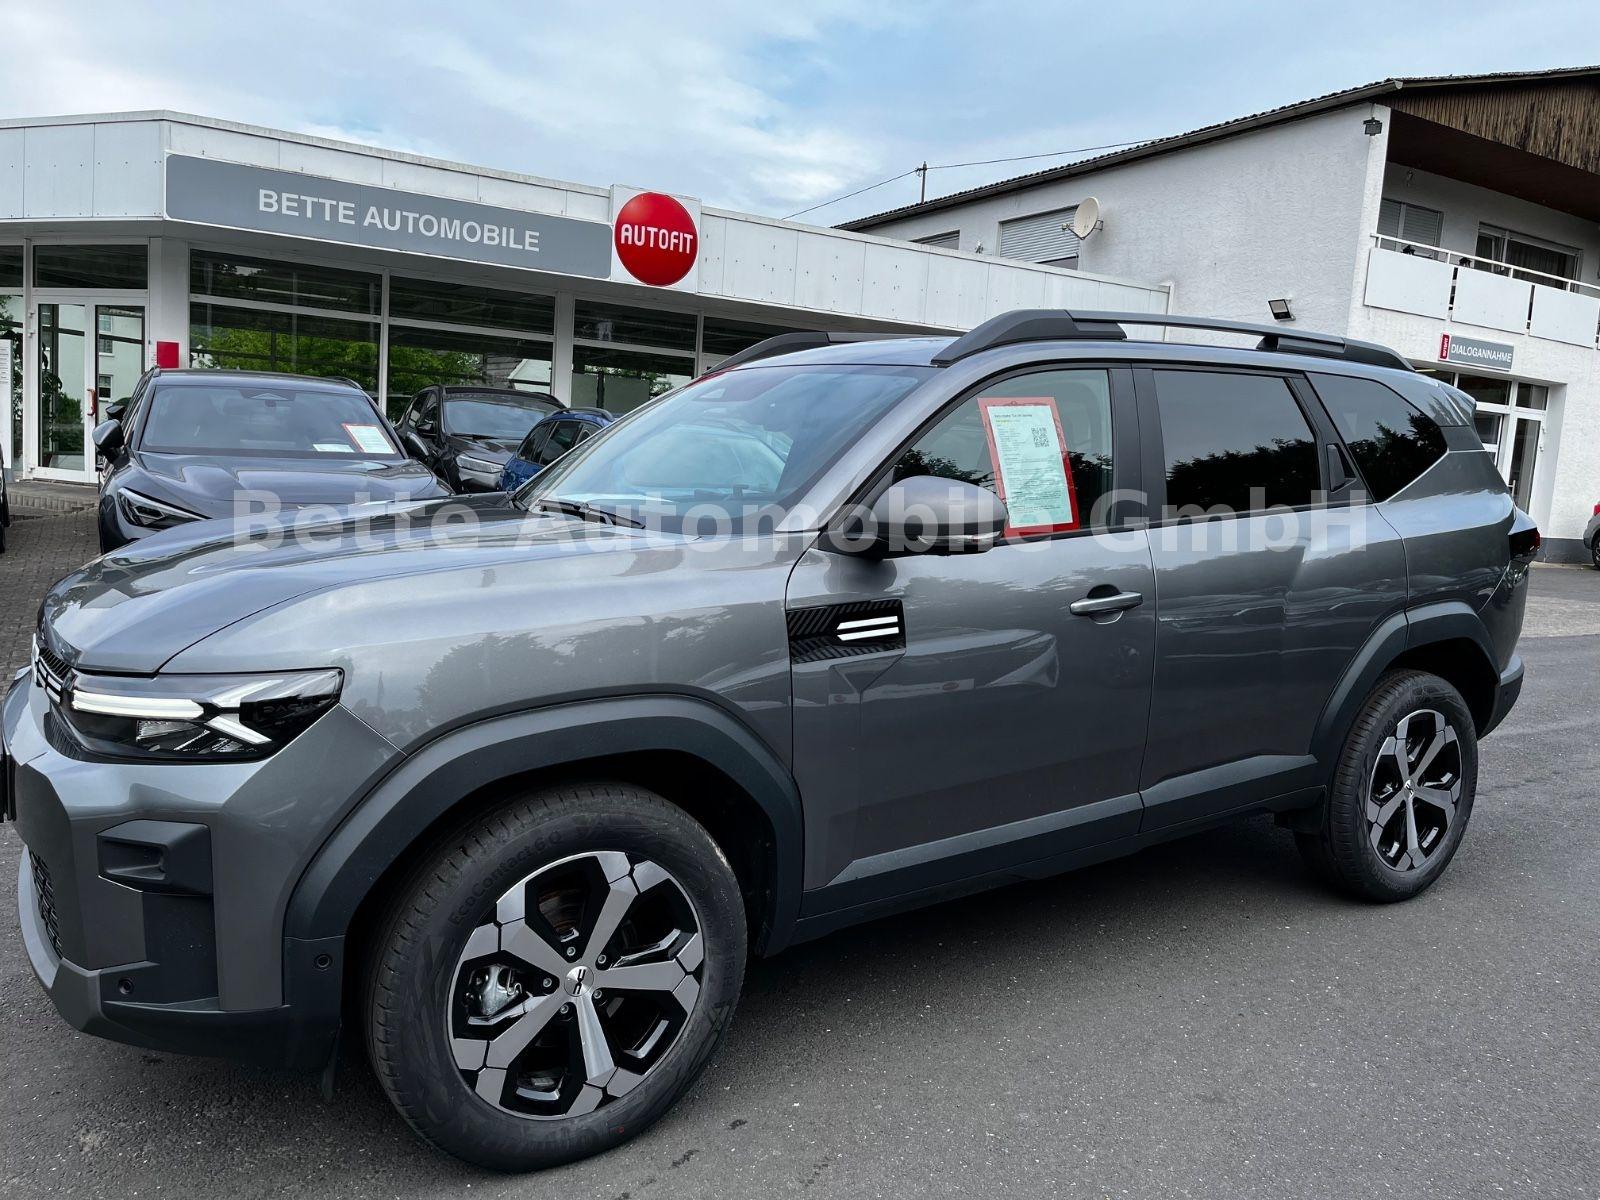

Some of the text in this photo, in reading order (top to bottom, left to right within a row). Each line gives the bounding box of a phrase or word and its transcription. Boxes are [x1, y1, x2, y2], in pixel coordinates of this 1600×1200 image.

[258, 188, 540, 252] BETTE AUTOMOBILE
[620, 223, 694, 254] AUTOFIT
[1451, 343, 1513, 363] DIALOGANNAHME
[447, 845, 531, 926] EcoContact
